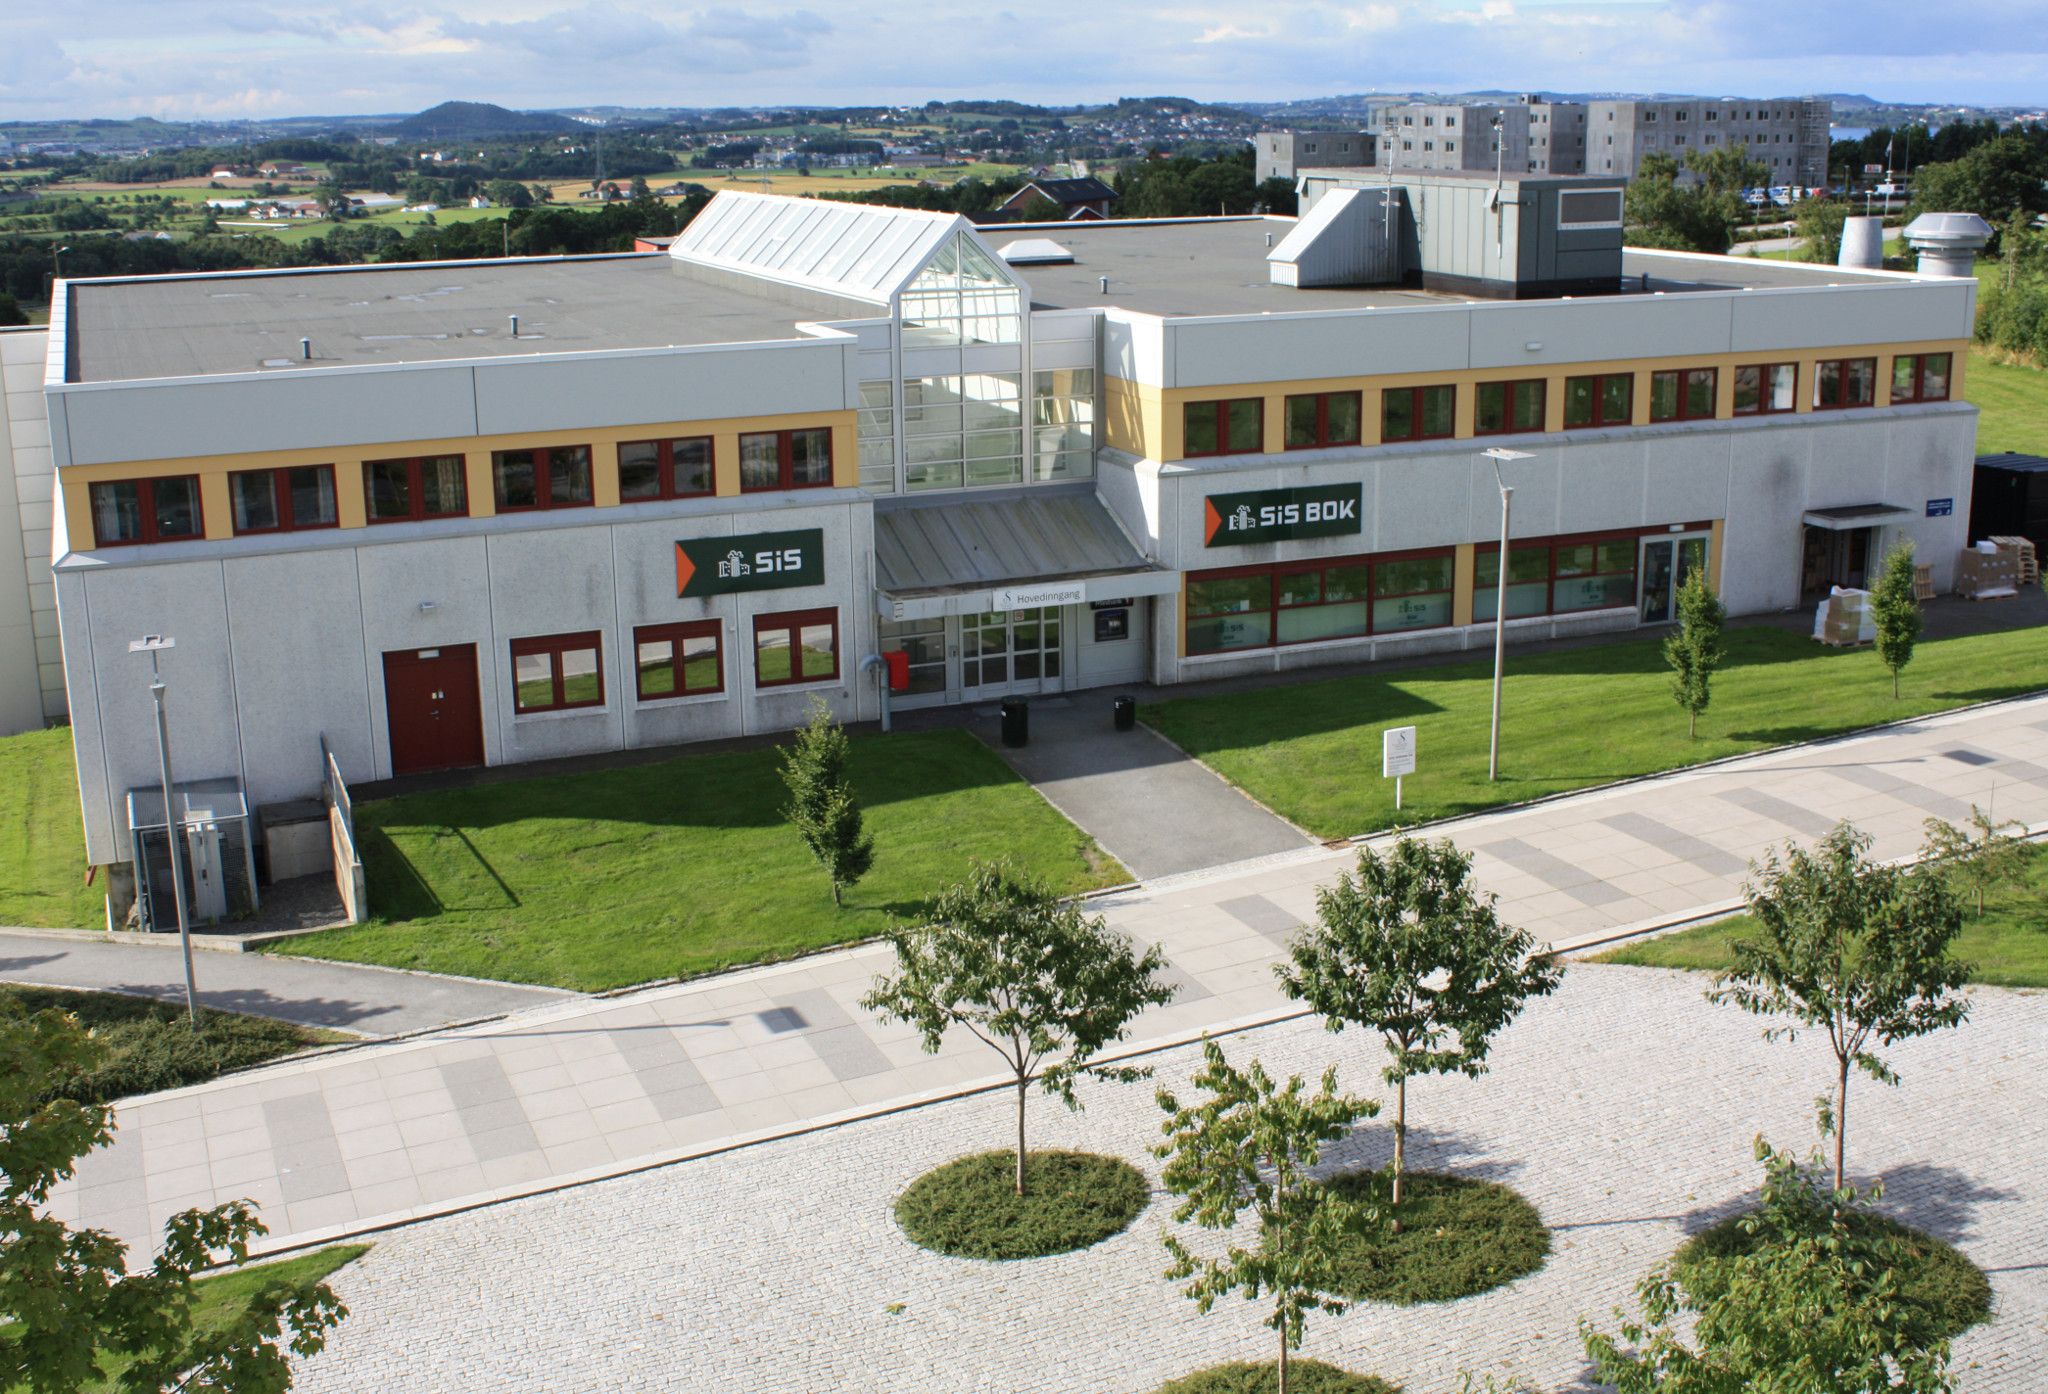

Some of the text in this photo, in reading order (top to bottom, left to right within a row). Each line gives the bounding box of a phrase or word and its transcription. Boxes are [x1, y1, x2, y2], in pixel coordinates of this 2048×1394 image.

[1260, 499, 1356, 527] SiS BOK
[755, 548, 802, 573] SiS
[1017, 590, 1081, 604] Hovedinngang
